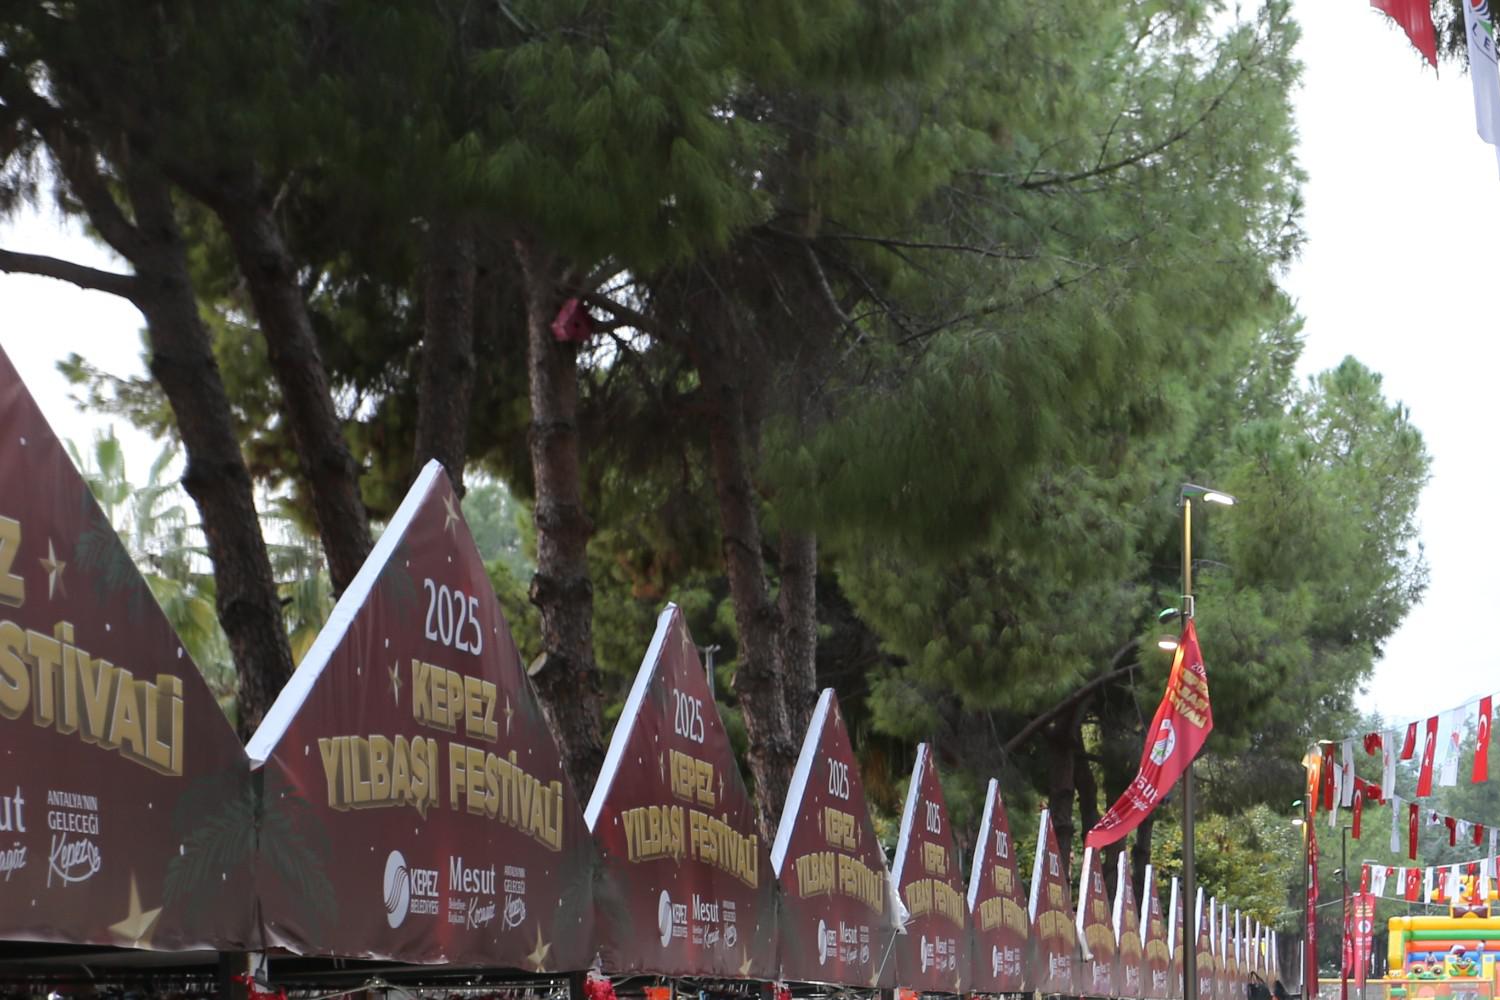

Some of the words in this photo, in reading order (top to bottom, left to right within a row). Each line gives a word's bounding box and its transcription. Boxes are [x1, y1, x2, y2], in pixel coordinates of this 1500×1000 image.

[424, 578, 483, 656] 2025
[411, 659, 499, 744] KEPEZ
[673, 688, 705, 744] 2025
[318, 734, 440, 821] YILBAŞI
[449, 742, 563, 852] FESTİVALİ
[669, 748, 715, 809] KEPEZ
[827, 757, 850, 801] 2025
[48, 810, 99, 835] GELECEĞİ
[621, 804, 687, 868] YILBAŞI
[689, 809, 759, 889] FESTİVALİ
[410, 867, 440, 897] KEPEZ
[448, 855, 497, 895] Mesut
[692, 893, 720, 923] Mesut
